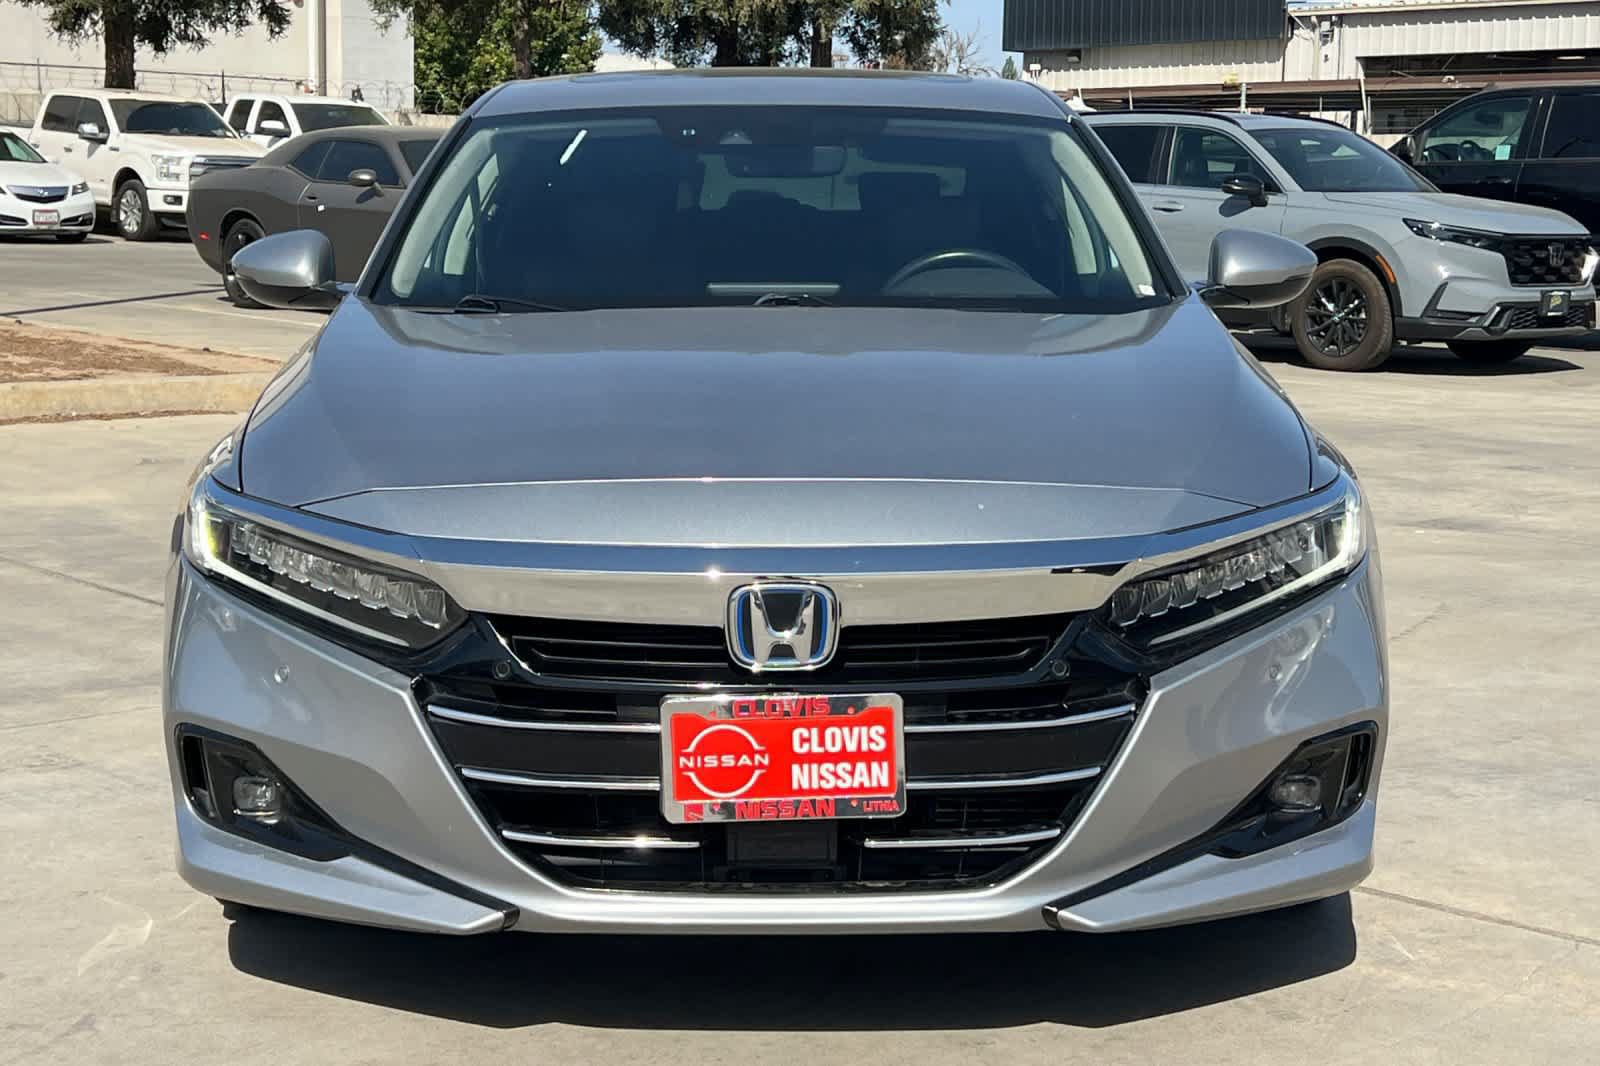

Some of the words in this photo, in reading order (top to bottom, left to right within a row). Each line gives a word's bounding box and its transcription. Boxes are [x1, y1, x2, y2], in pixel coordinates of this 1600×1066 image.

[732, 697, 831, 718] CLOVIS
[791, 726, 886, 753] CLOVIS
[679, 753, 769, 768] NISSAN
[791, 762, 889, 789] NISSAN
[735, 799, 835, 819] NISSAN
